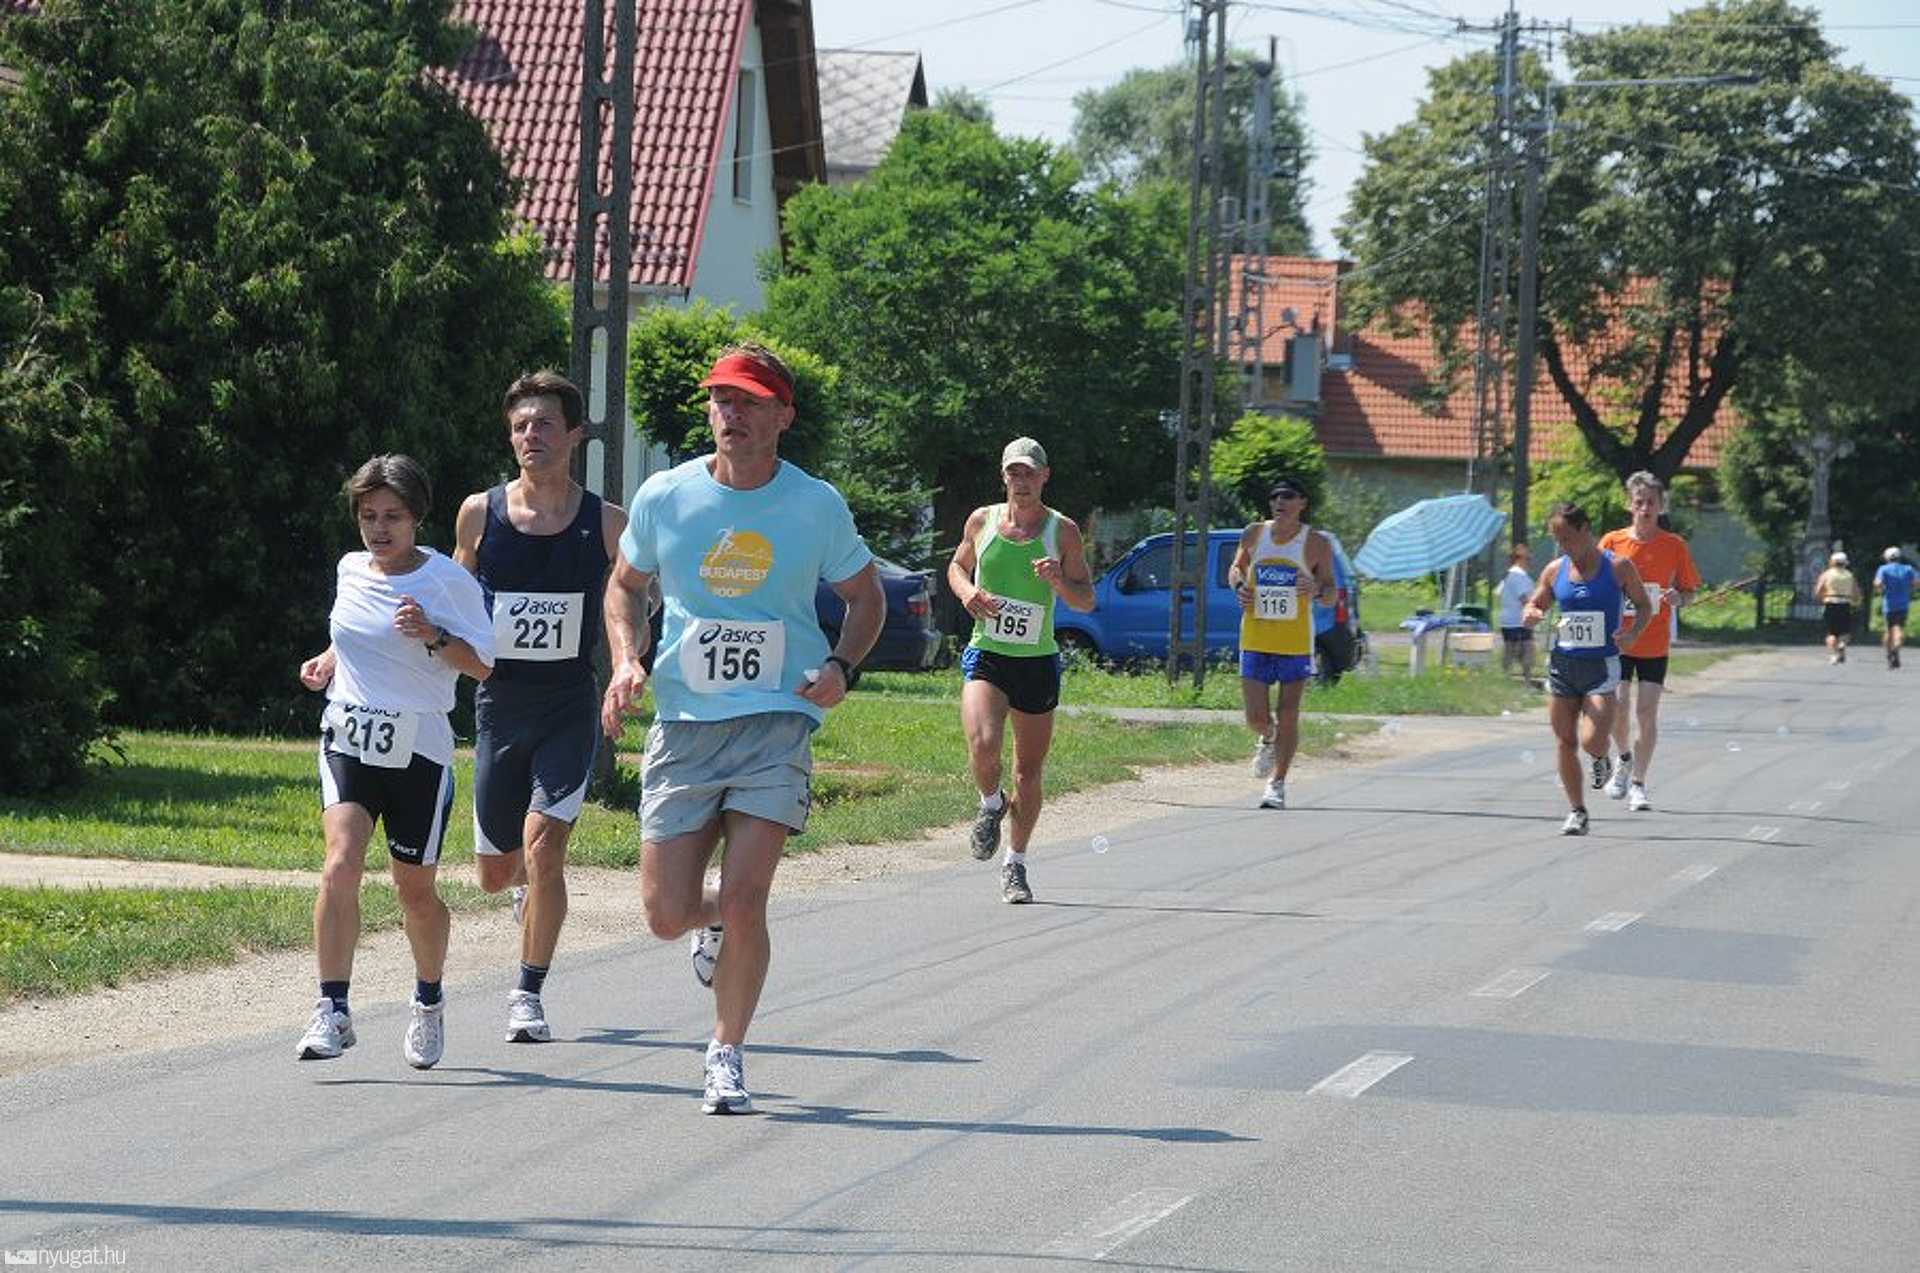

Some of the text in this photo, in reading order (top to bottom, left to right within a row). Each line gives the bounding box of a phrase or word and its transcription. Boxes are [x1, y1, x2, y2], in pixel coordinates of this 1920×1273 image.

[528, 601, 568, 615] asics
[1262, 599, 1287, 615] 116
[514, 618, 563, 649] 221
[721, 628, 767, 644] asics
[994, 614, 1028, 637] 195
[703, 645, 760, 681] 156
[345, 716, 396, 755] 213
